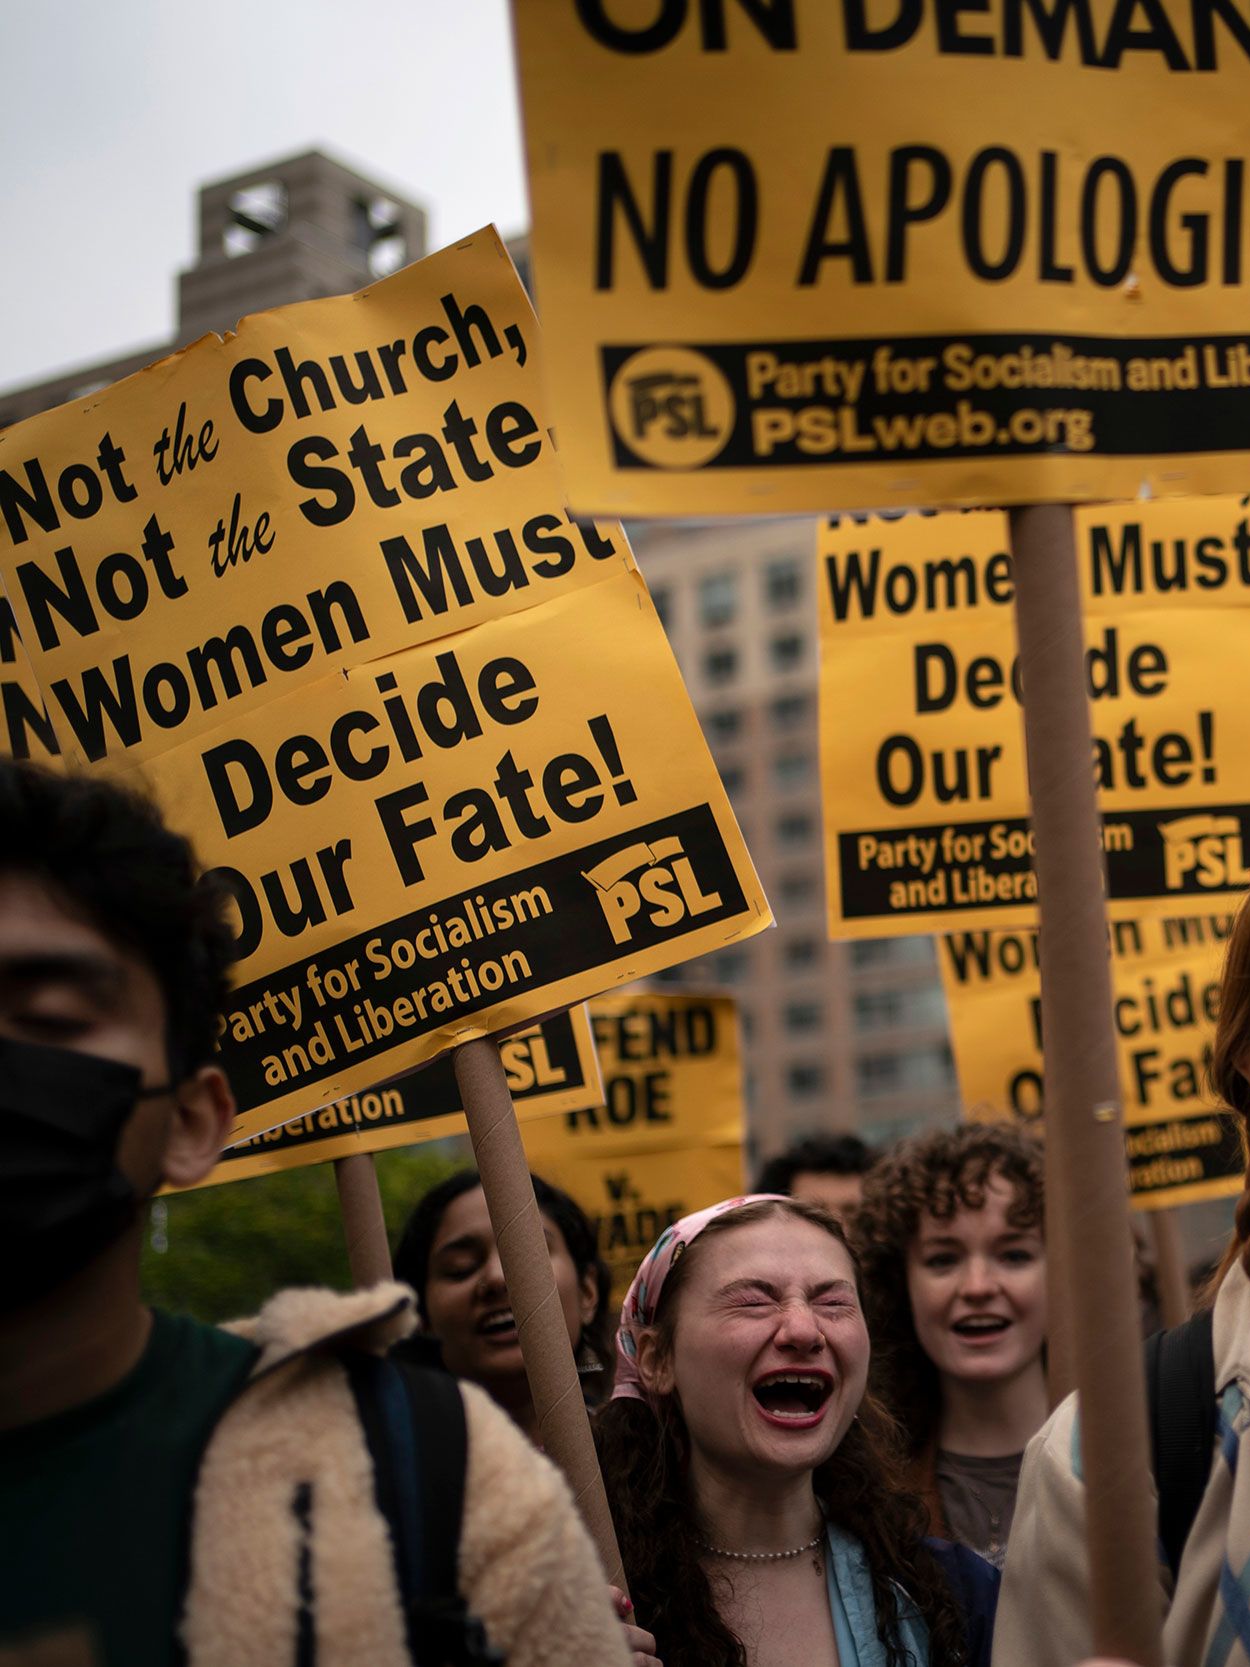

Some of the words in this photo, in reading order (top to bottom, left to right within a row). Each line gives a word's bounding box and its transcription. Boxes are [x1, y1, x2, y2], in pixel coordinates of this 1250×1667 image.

[594, 145, 760, 293] NO
[0, 431, 138, 545] Not
[153, 401, 220, 487] the
[228, 293, 529, 435] Church,
[632, 393, 718, 441] PSL
[746, 352, 862, 401] Party
[872, 347, 936, 394] for
[943, 344, 1120, 391] Socialism
[1125, 348, 1196, 390] and
[752, 406, 1094, 455] PSLweb.org
[15, 512, 189, 652] Not
[207, 492, 276, 579] the
[285, 398, 556, 528] State
[826, 548, 1017, 624] Wome
[50, 580, 370, 763] Women
[202, 650, 539, 839] Decide
[876, 733, 1004, 809] Our
[1093, 710, 1218, 792] ate!
[375, 714, 638, 888] Fate!
[595, 856, 724, 945] PSL
[857, 830, 938, 874] Party
[942, 829, 983, 862] for
[889, 870, 946, 909] and
[306, 963, 362, 1007] for
[365, 886, 554, 981] Socialism
[261, 1020, 336, 1086] and
[334, 949, 533, 1053] Liberation
[501, 1034, 567, 1093] SL
